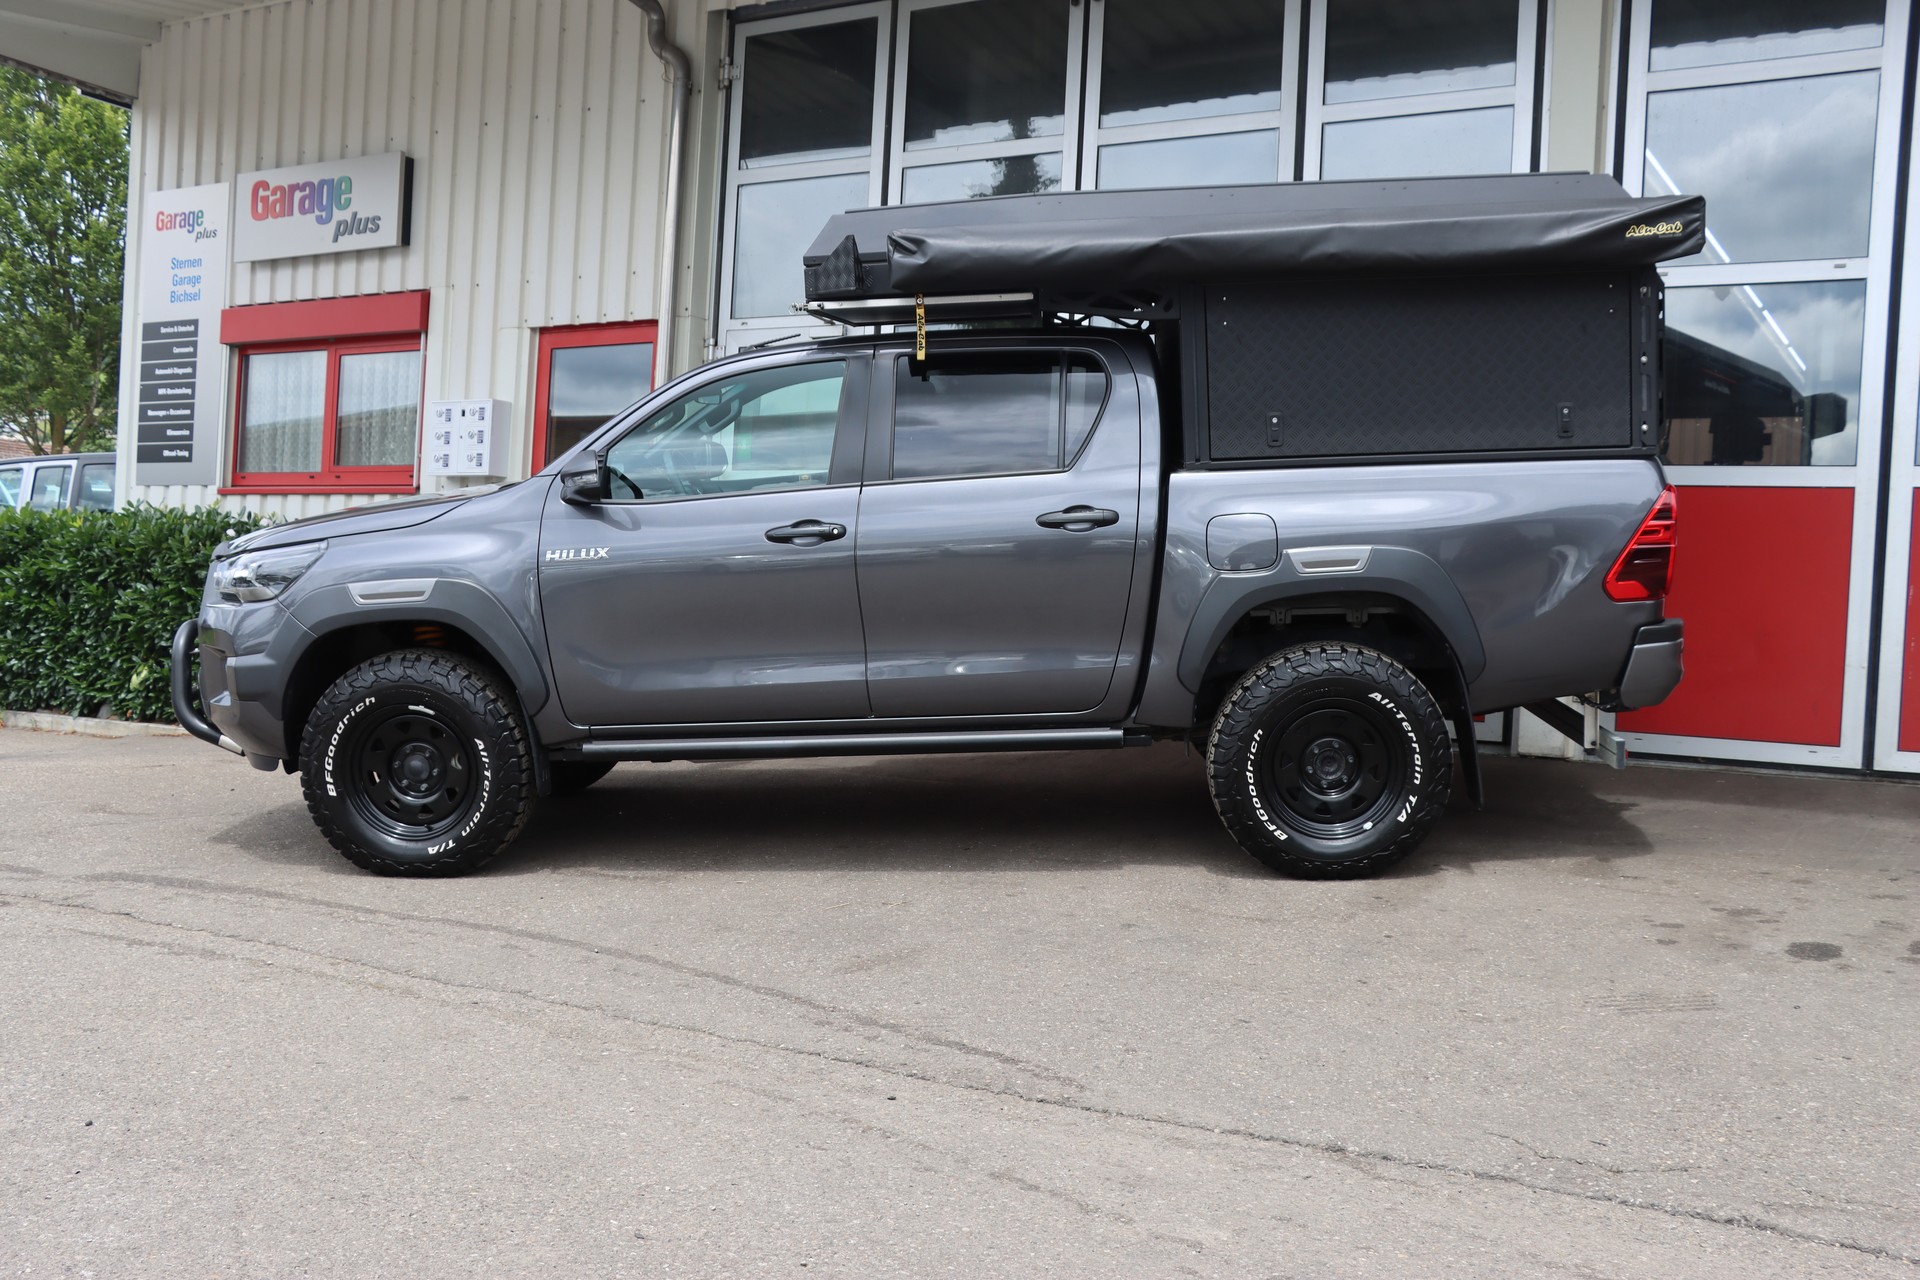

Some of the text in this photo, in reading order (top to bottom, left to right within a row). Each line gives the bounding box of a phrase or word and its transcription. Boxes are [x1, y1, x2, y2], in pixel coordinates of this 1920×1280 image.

[251, 175, 352, 225] Garage
[156, 209, 204, 234] Garage
[195, 227, 218, 243] plus
[332, 211, 381, 243] plus
[171, 257, 202, 270] Sternen
[170, 288, 201, 303] Bichsel
[172, 274, 202, 287] Garage
[917, 313, 925, 351] Alu-Cab
[545, 546, 611, 561] HILUX
[324, 696, 376, 797] BFGoodrich
[1368, 691, 1423, 823] All-Terrain T/A
[427, 737, 492, 855] All-Terrain T/A
[1245, 728, 1289, 841] BFGoodrich
